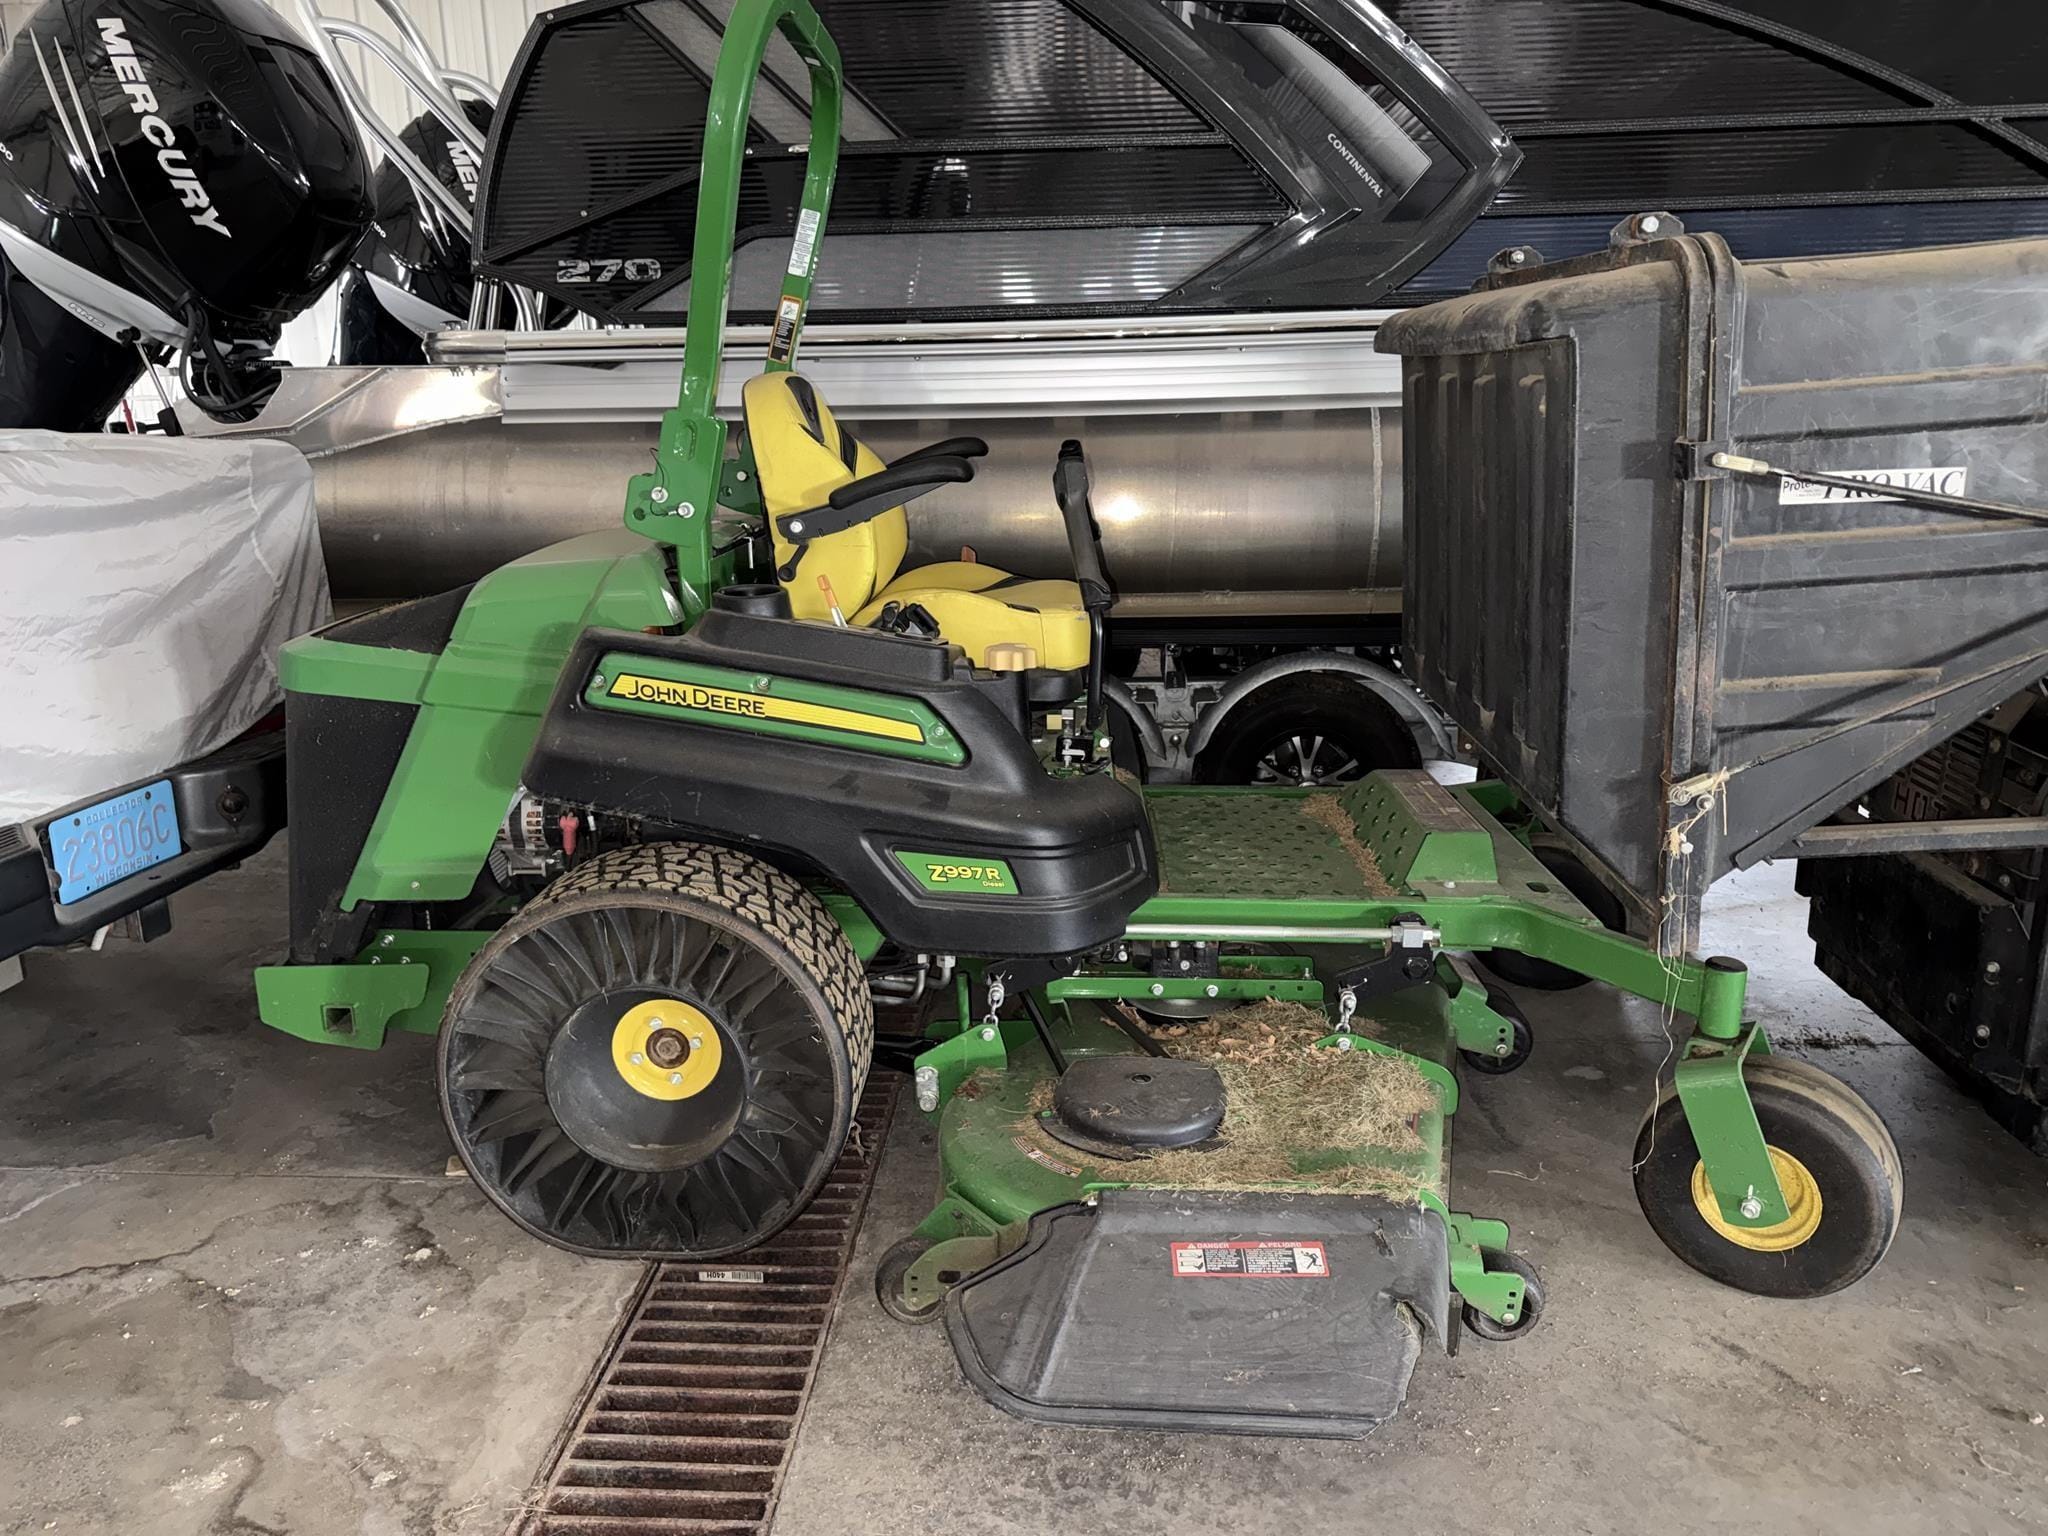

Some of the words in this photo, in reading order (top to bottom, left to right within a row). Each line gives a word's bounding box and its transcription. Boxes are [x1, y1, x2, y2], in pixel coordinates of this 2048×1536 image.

[96, 18, 232, 238] MERCURY
[1327, 133, 1384, 198] CONTINENTAL
[557, 259, 661, 282] 270
[1903, 470, 1964, 497] VAC
[628, 680, 687, 703] JOHN
[693, 688, 765, 715] DEERE
[86, 797, 143, 826] COLLECTOR
[63, 804, 169, 883] 23806C
[95, 855, 153, 888] WISCONSIN
